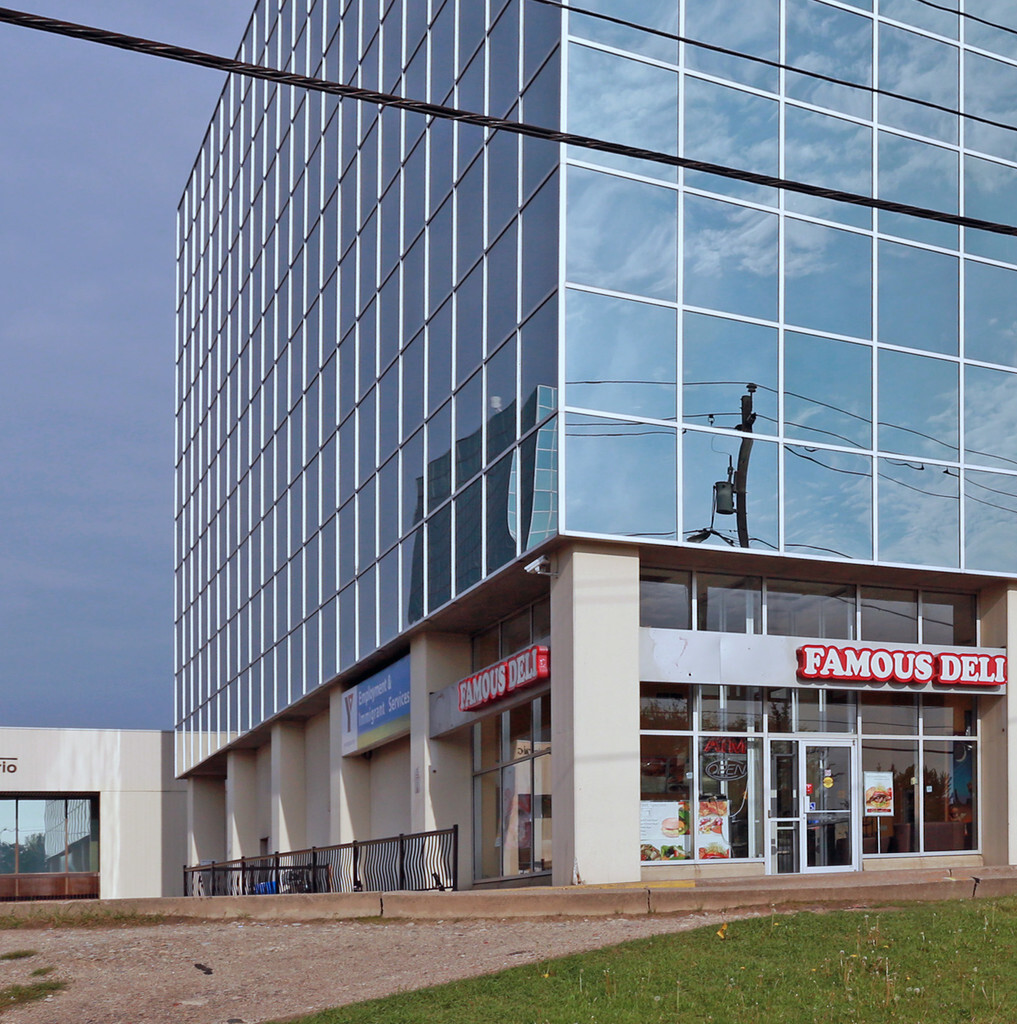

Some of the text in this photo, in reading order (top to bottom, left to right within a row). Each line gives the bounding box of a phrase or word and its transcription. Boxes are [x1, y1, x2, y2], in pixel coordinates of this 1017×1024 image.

[803, 647, 1007, 683] FAMOUS DELI
[459, 648, 537, 710] FAMOUS DELI
[359, 679, 388, 706] Employment
[388, 691, 410, 712] Services
[704, 738, 746, 754] ATM
[709, 764, 747, 776] OPEN
